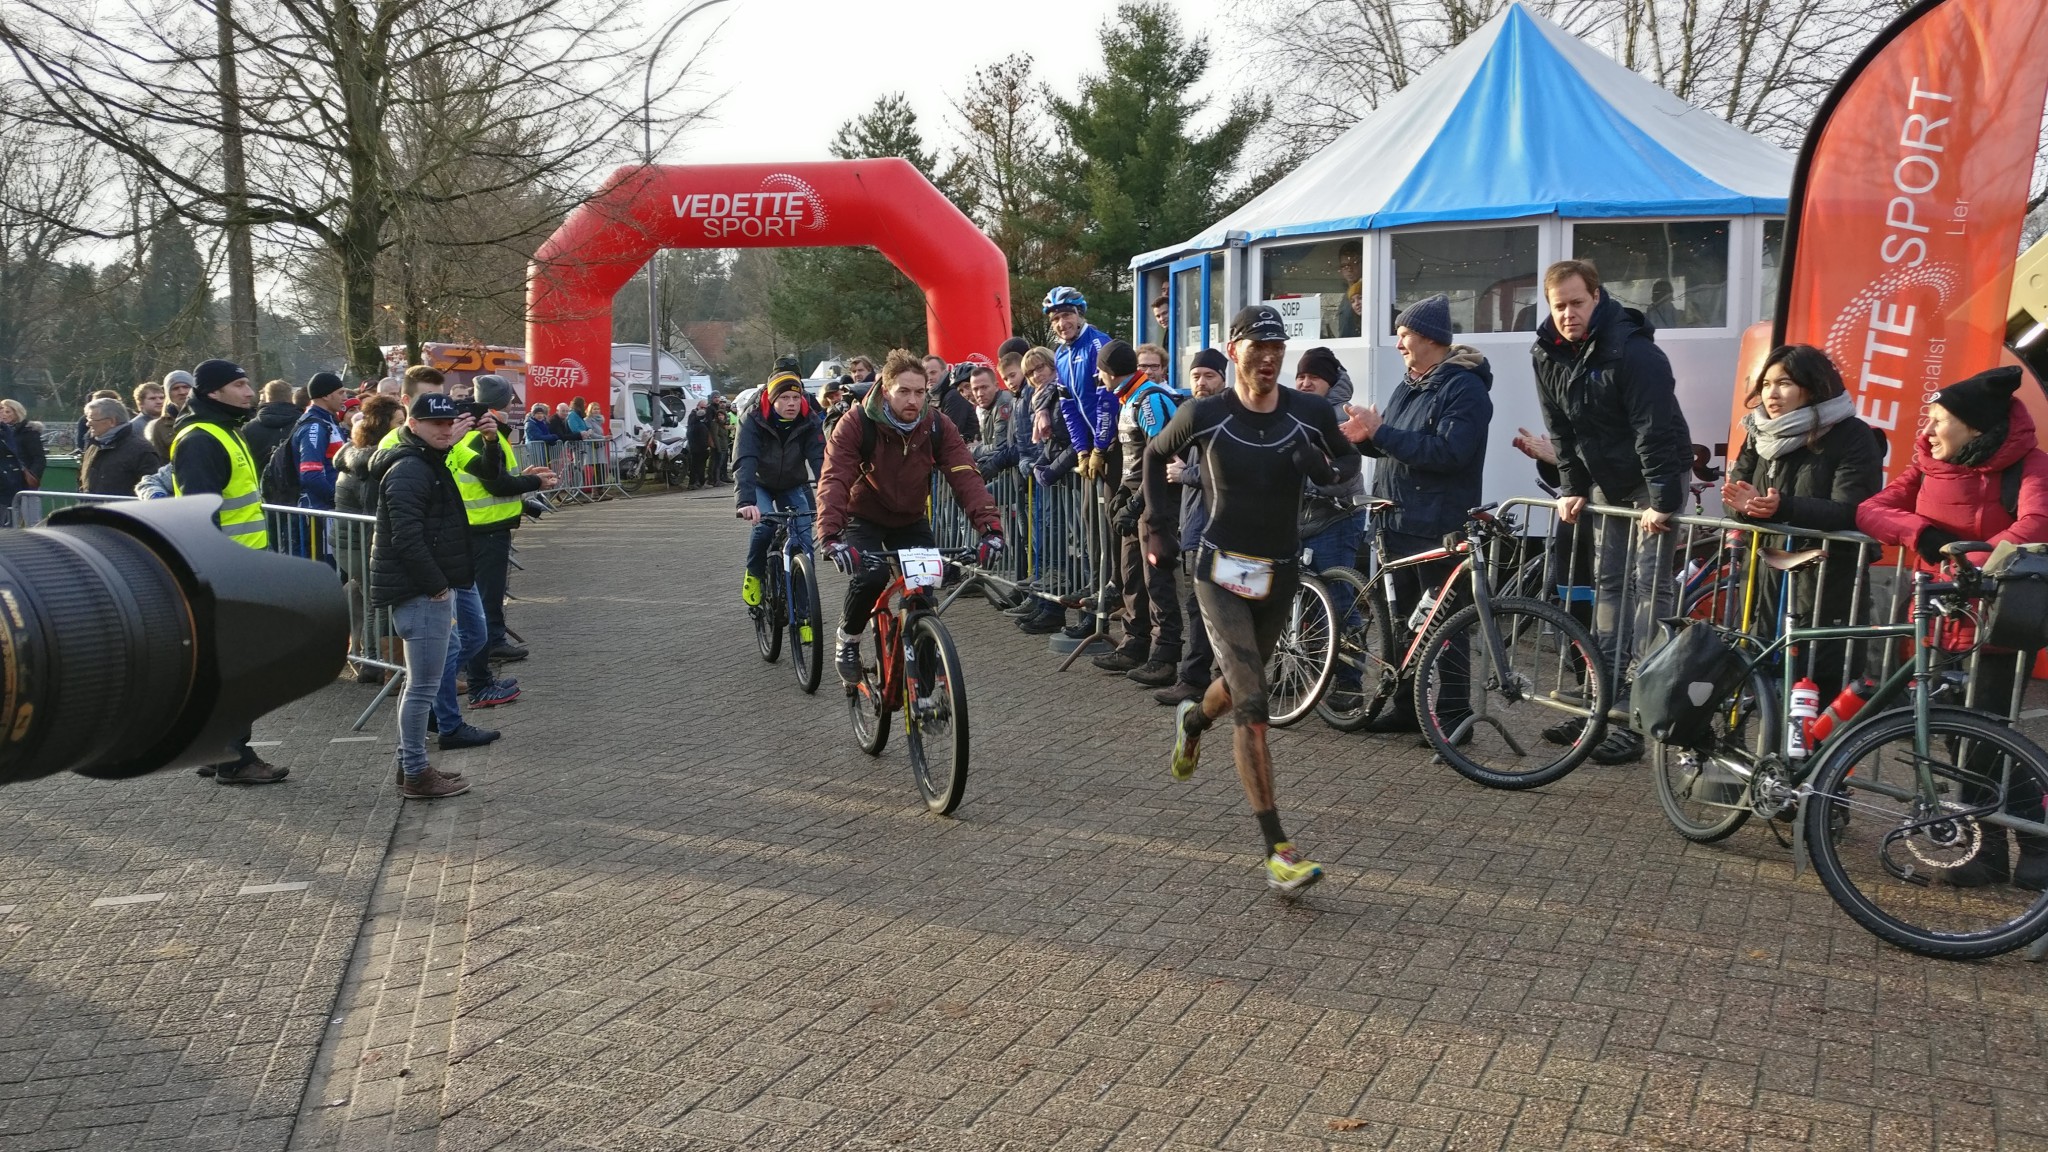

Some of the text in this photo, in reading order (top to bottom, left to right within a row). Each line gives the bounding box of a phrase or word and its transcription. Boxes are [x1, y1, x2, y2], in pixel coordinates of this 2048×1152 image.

[1881, 77, 1952, 268] SPORT
[672, 192, 804, 219] VEDETTE
[1945, 197, 1970, 236] Lier
[703, 216, 797, 238] SPORT
[1281, 302, 1300, 316] SOEP
[1284, 323, 1304, 337] PILER
[528, 365, 579, 378] VEDETTE
[534, 376, 578, 388] SPORT
[919, 562, 927, 573] 1
[0, 589, 25, 628] Nikon
